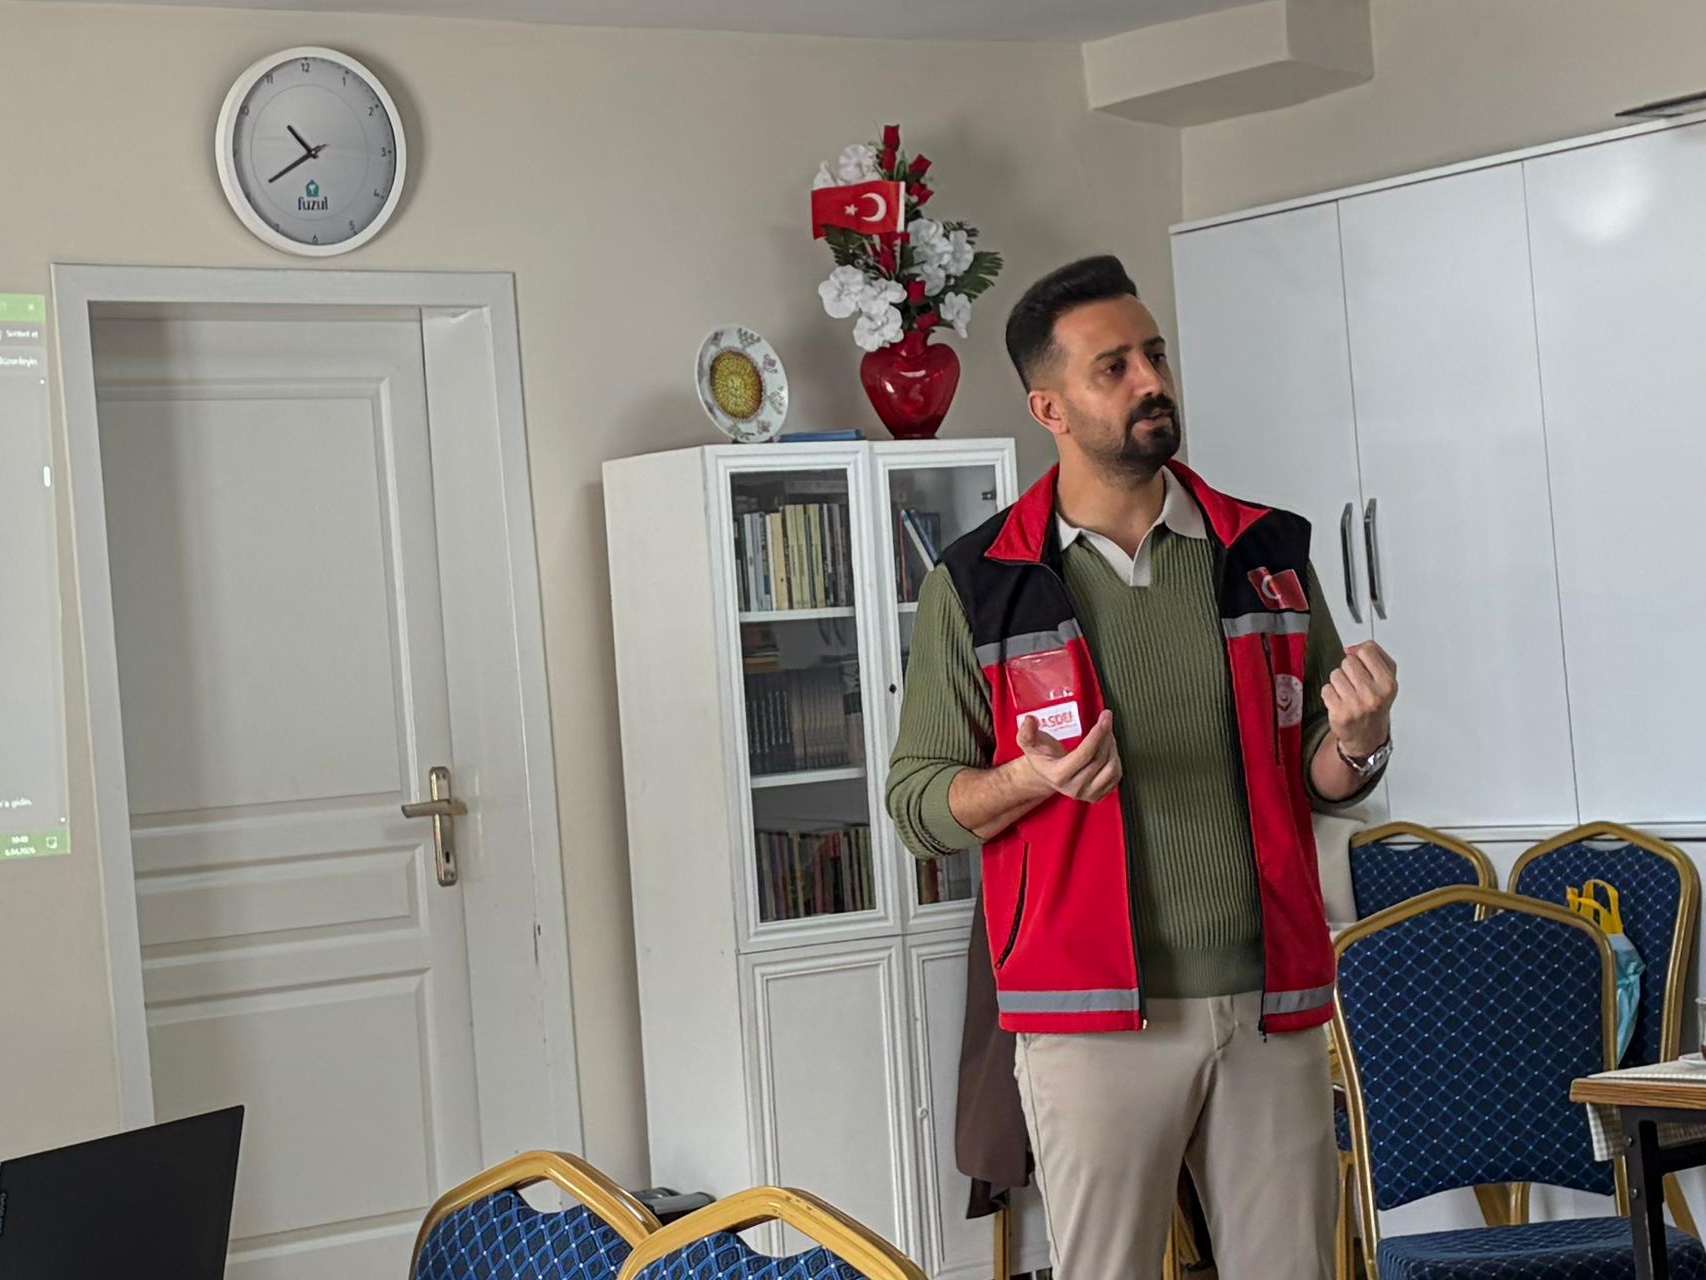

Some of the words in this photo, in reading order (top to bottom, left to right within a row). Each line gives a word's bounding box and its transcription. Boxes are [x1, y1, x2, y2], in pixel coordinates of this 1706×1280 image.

[301, 63, 310, 72] 12
[342, 77, 347, 86] 1
[368, 107, 374, 116] 2
[297, 196, 329, 211] fuzul
